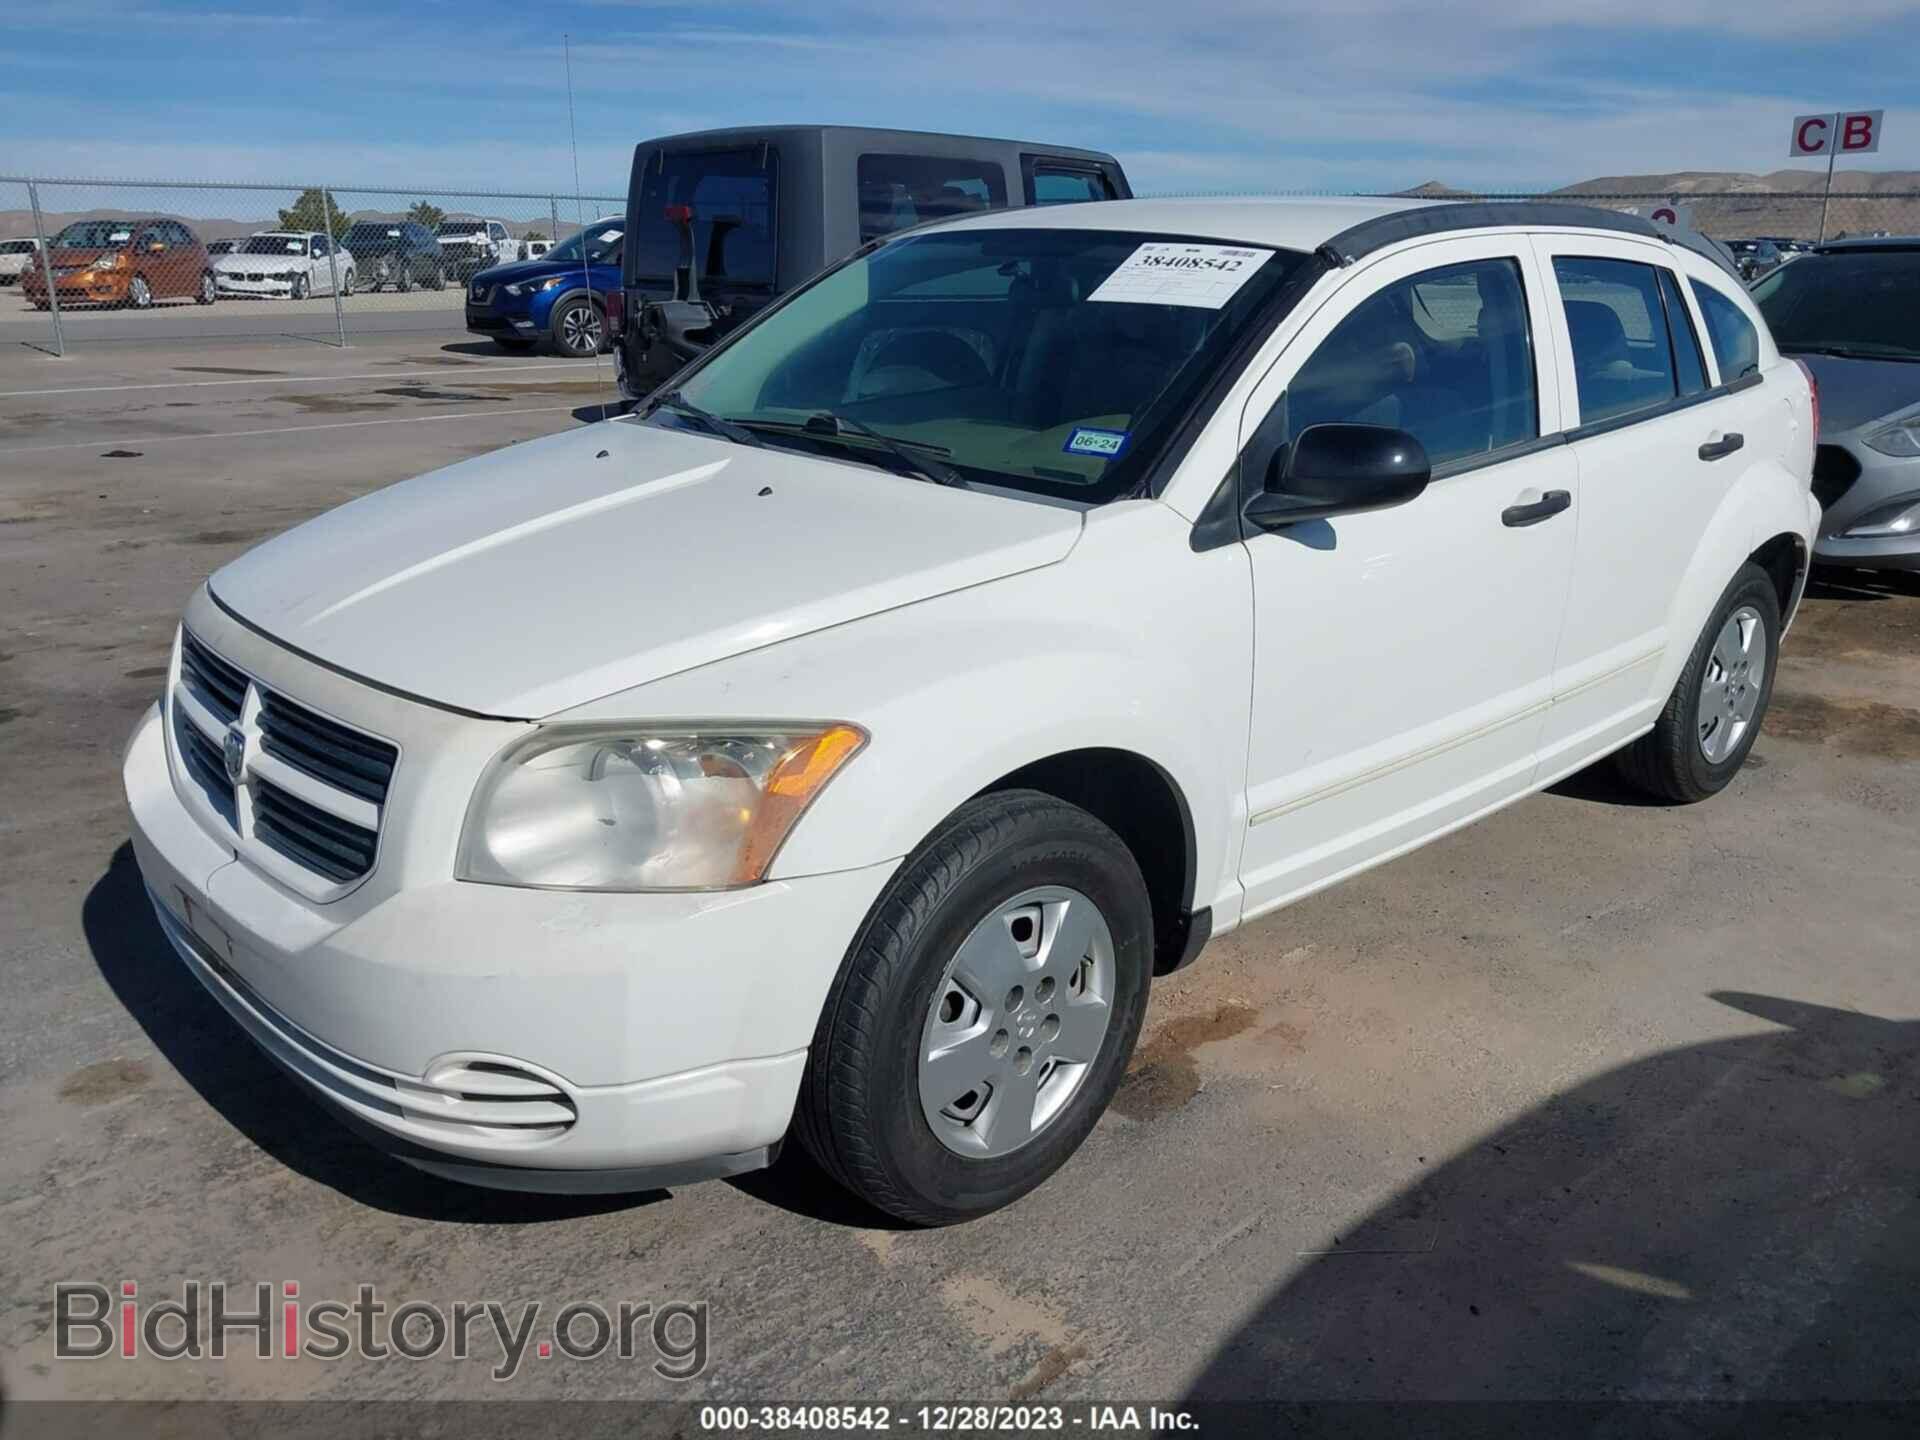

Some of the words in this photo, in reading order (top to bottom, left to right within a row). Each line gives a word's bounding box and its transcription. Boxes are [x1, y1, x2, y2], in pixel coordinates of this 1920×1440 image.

[1798, 118, 1826, 152] C
[1842, 115, 1873, 150] B
[1135, 255, 1242, 272] 38408542
